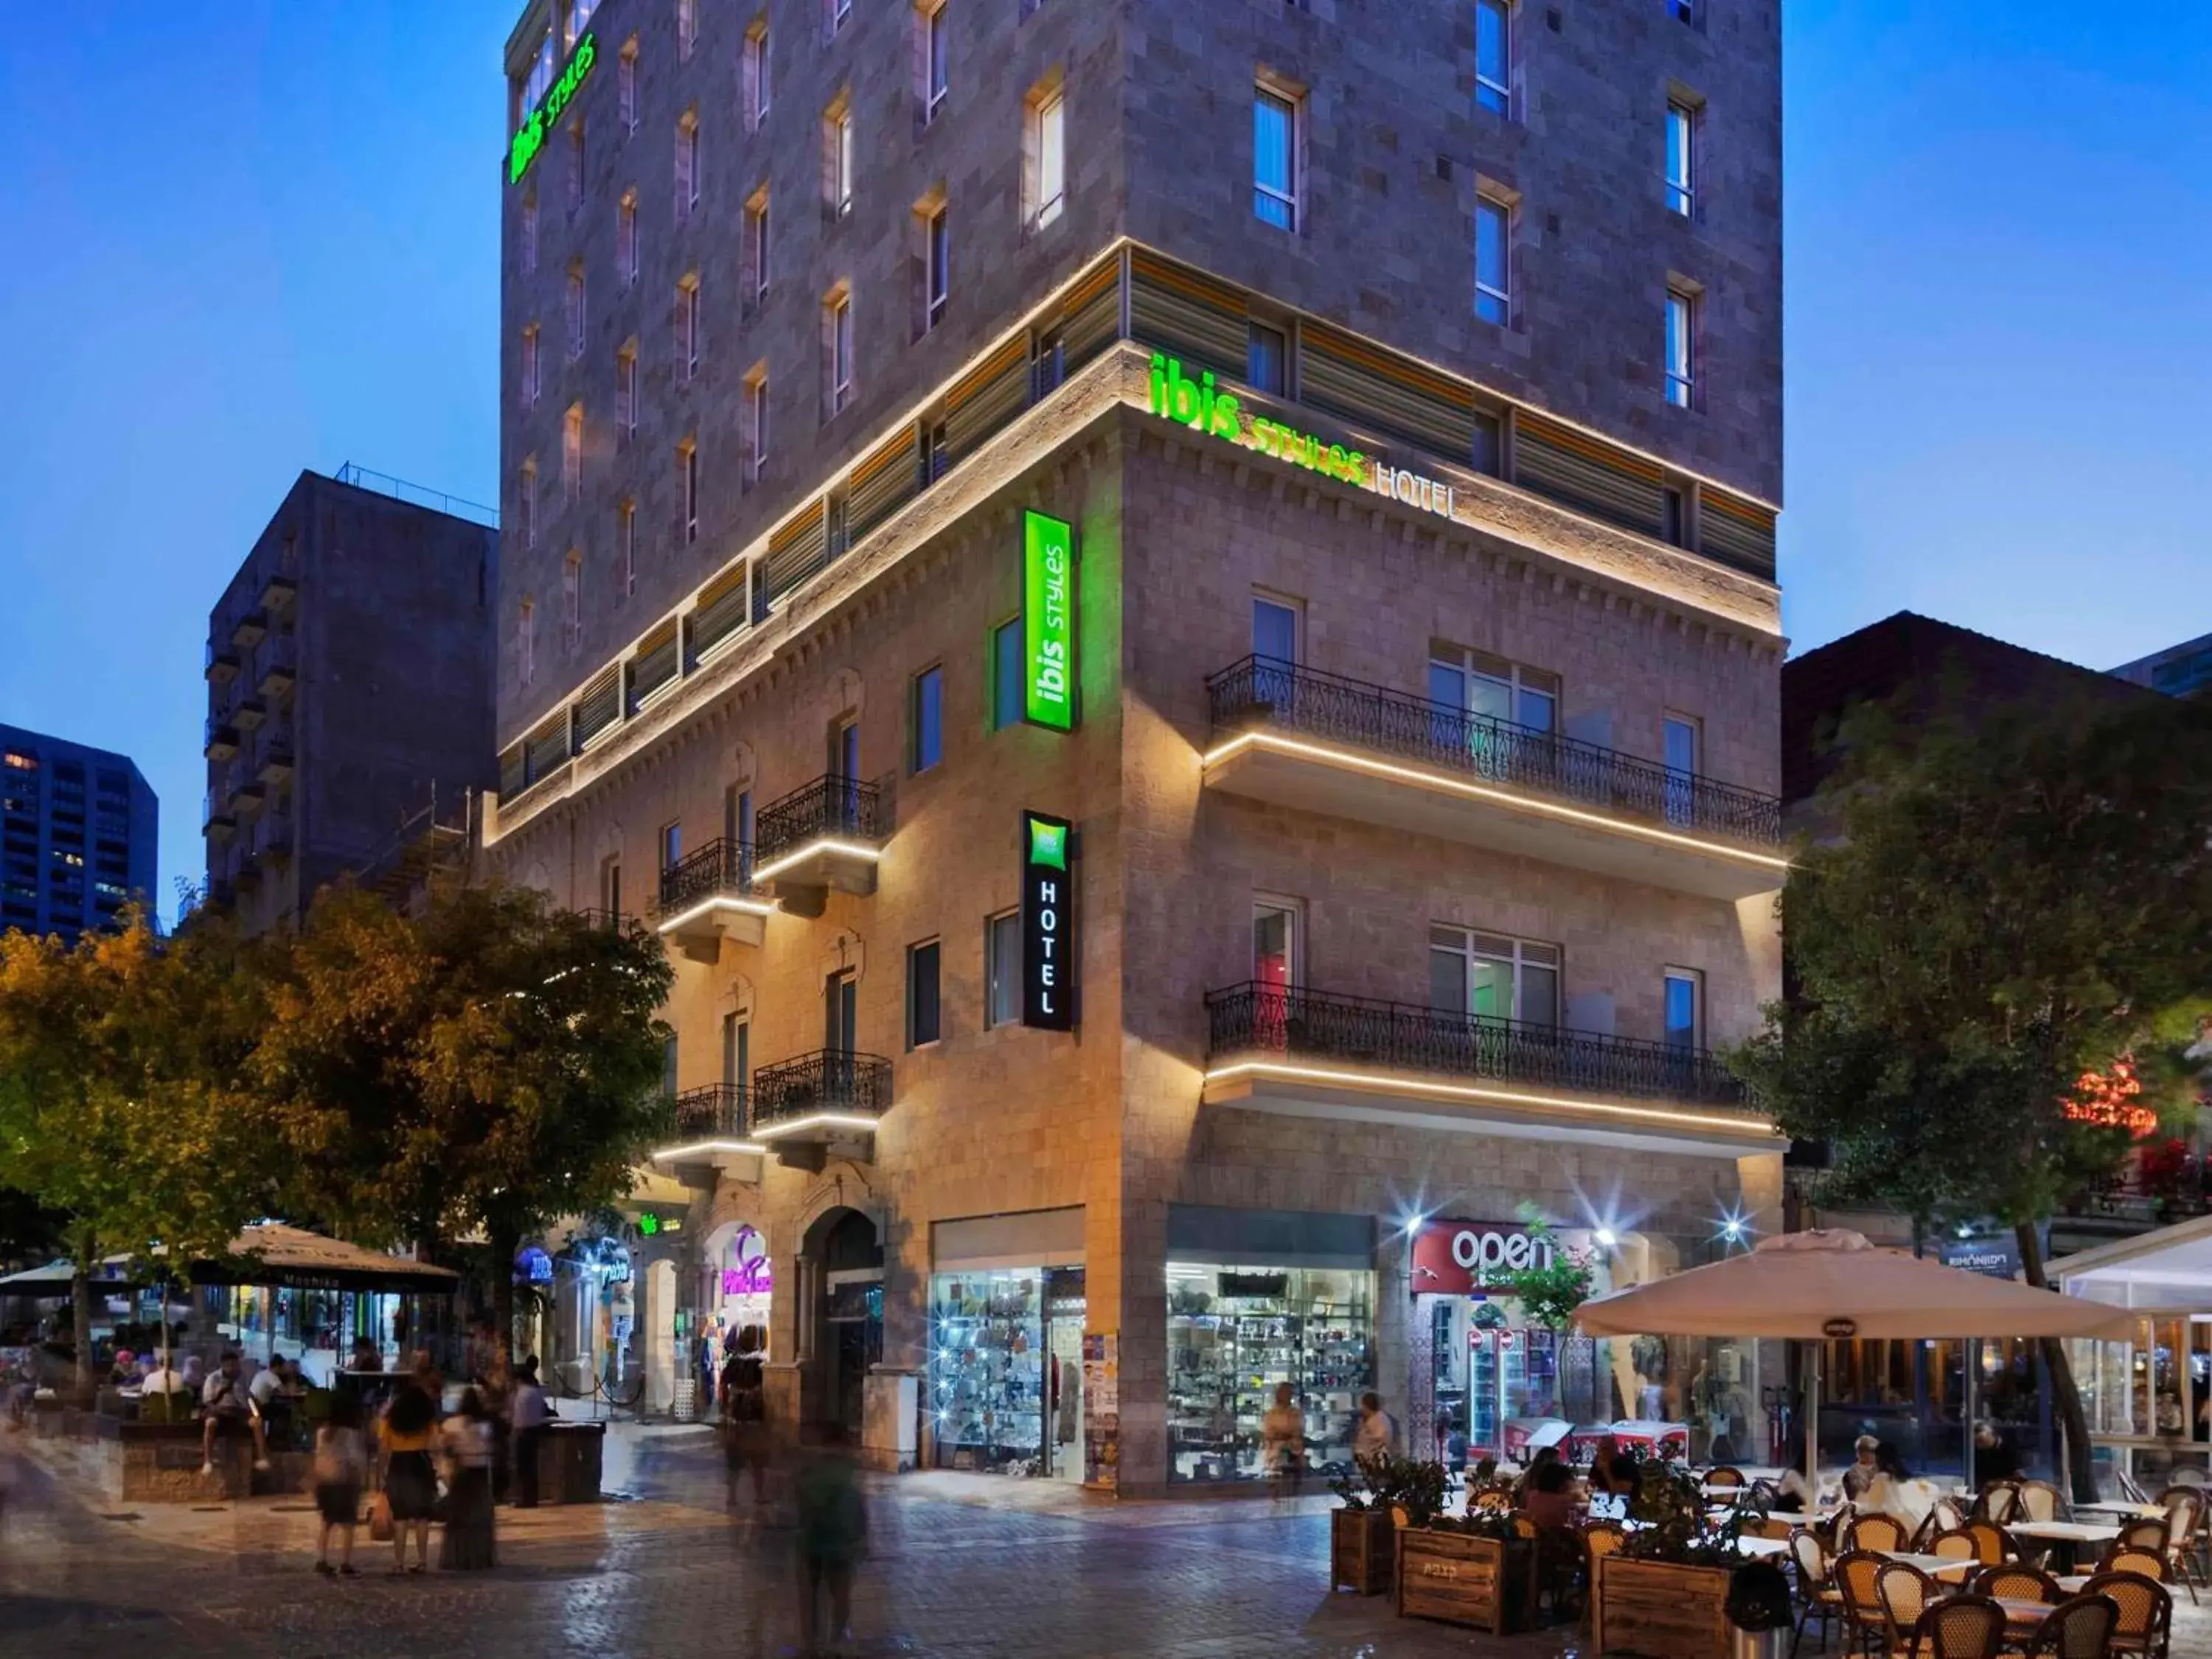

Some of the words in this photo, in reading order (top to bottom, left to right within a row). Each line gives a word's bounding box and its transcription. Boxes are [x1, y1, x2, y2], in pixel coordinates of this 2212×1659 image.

[1149, 352, 1241, 441] ibis
[1374, 462, 1456, 518] HOTEL
[1046, 544, 1064, 630] STYLES
[1035, 639, 1065, 703] ibis
[1041, 881, 1057, 1015] HOTEL
[1453, 1230, 1551, 1287] open
